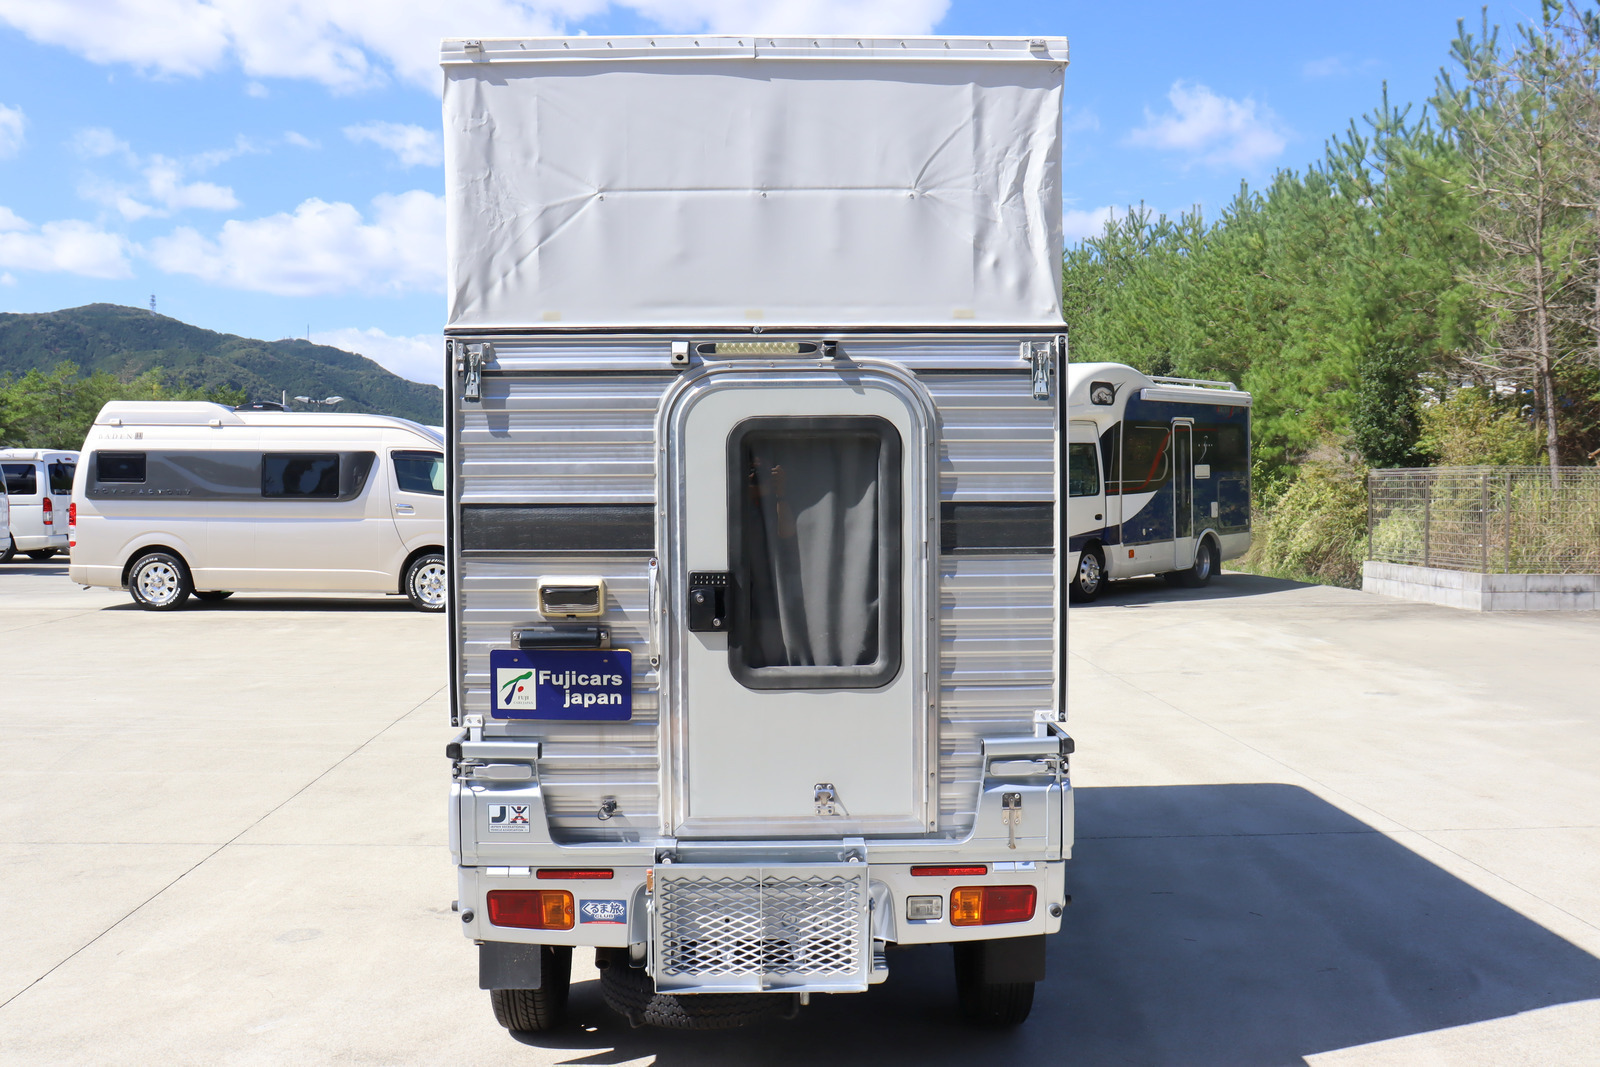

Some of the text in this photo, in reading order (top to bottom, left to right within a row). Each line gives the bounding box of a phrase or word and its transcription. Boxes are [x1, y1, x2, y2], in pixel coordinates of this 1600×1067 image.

[538, 670, 623, 689] Fujicars
[563, 690, 622, 708] japan
[581, 902, 625, 915] くるま旅
